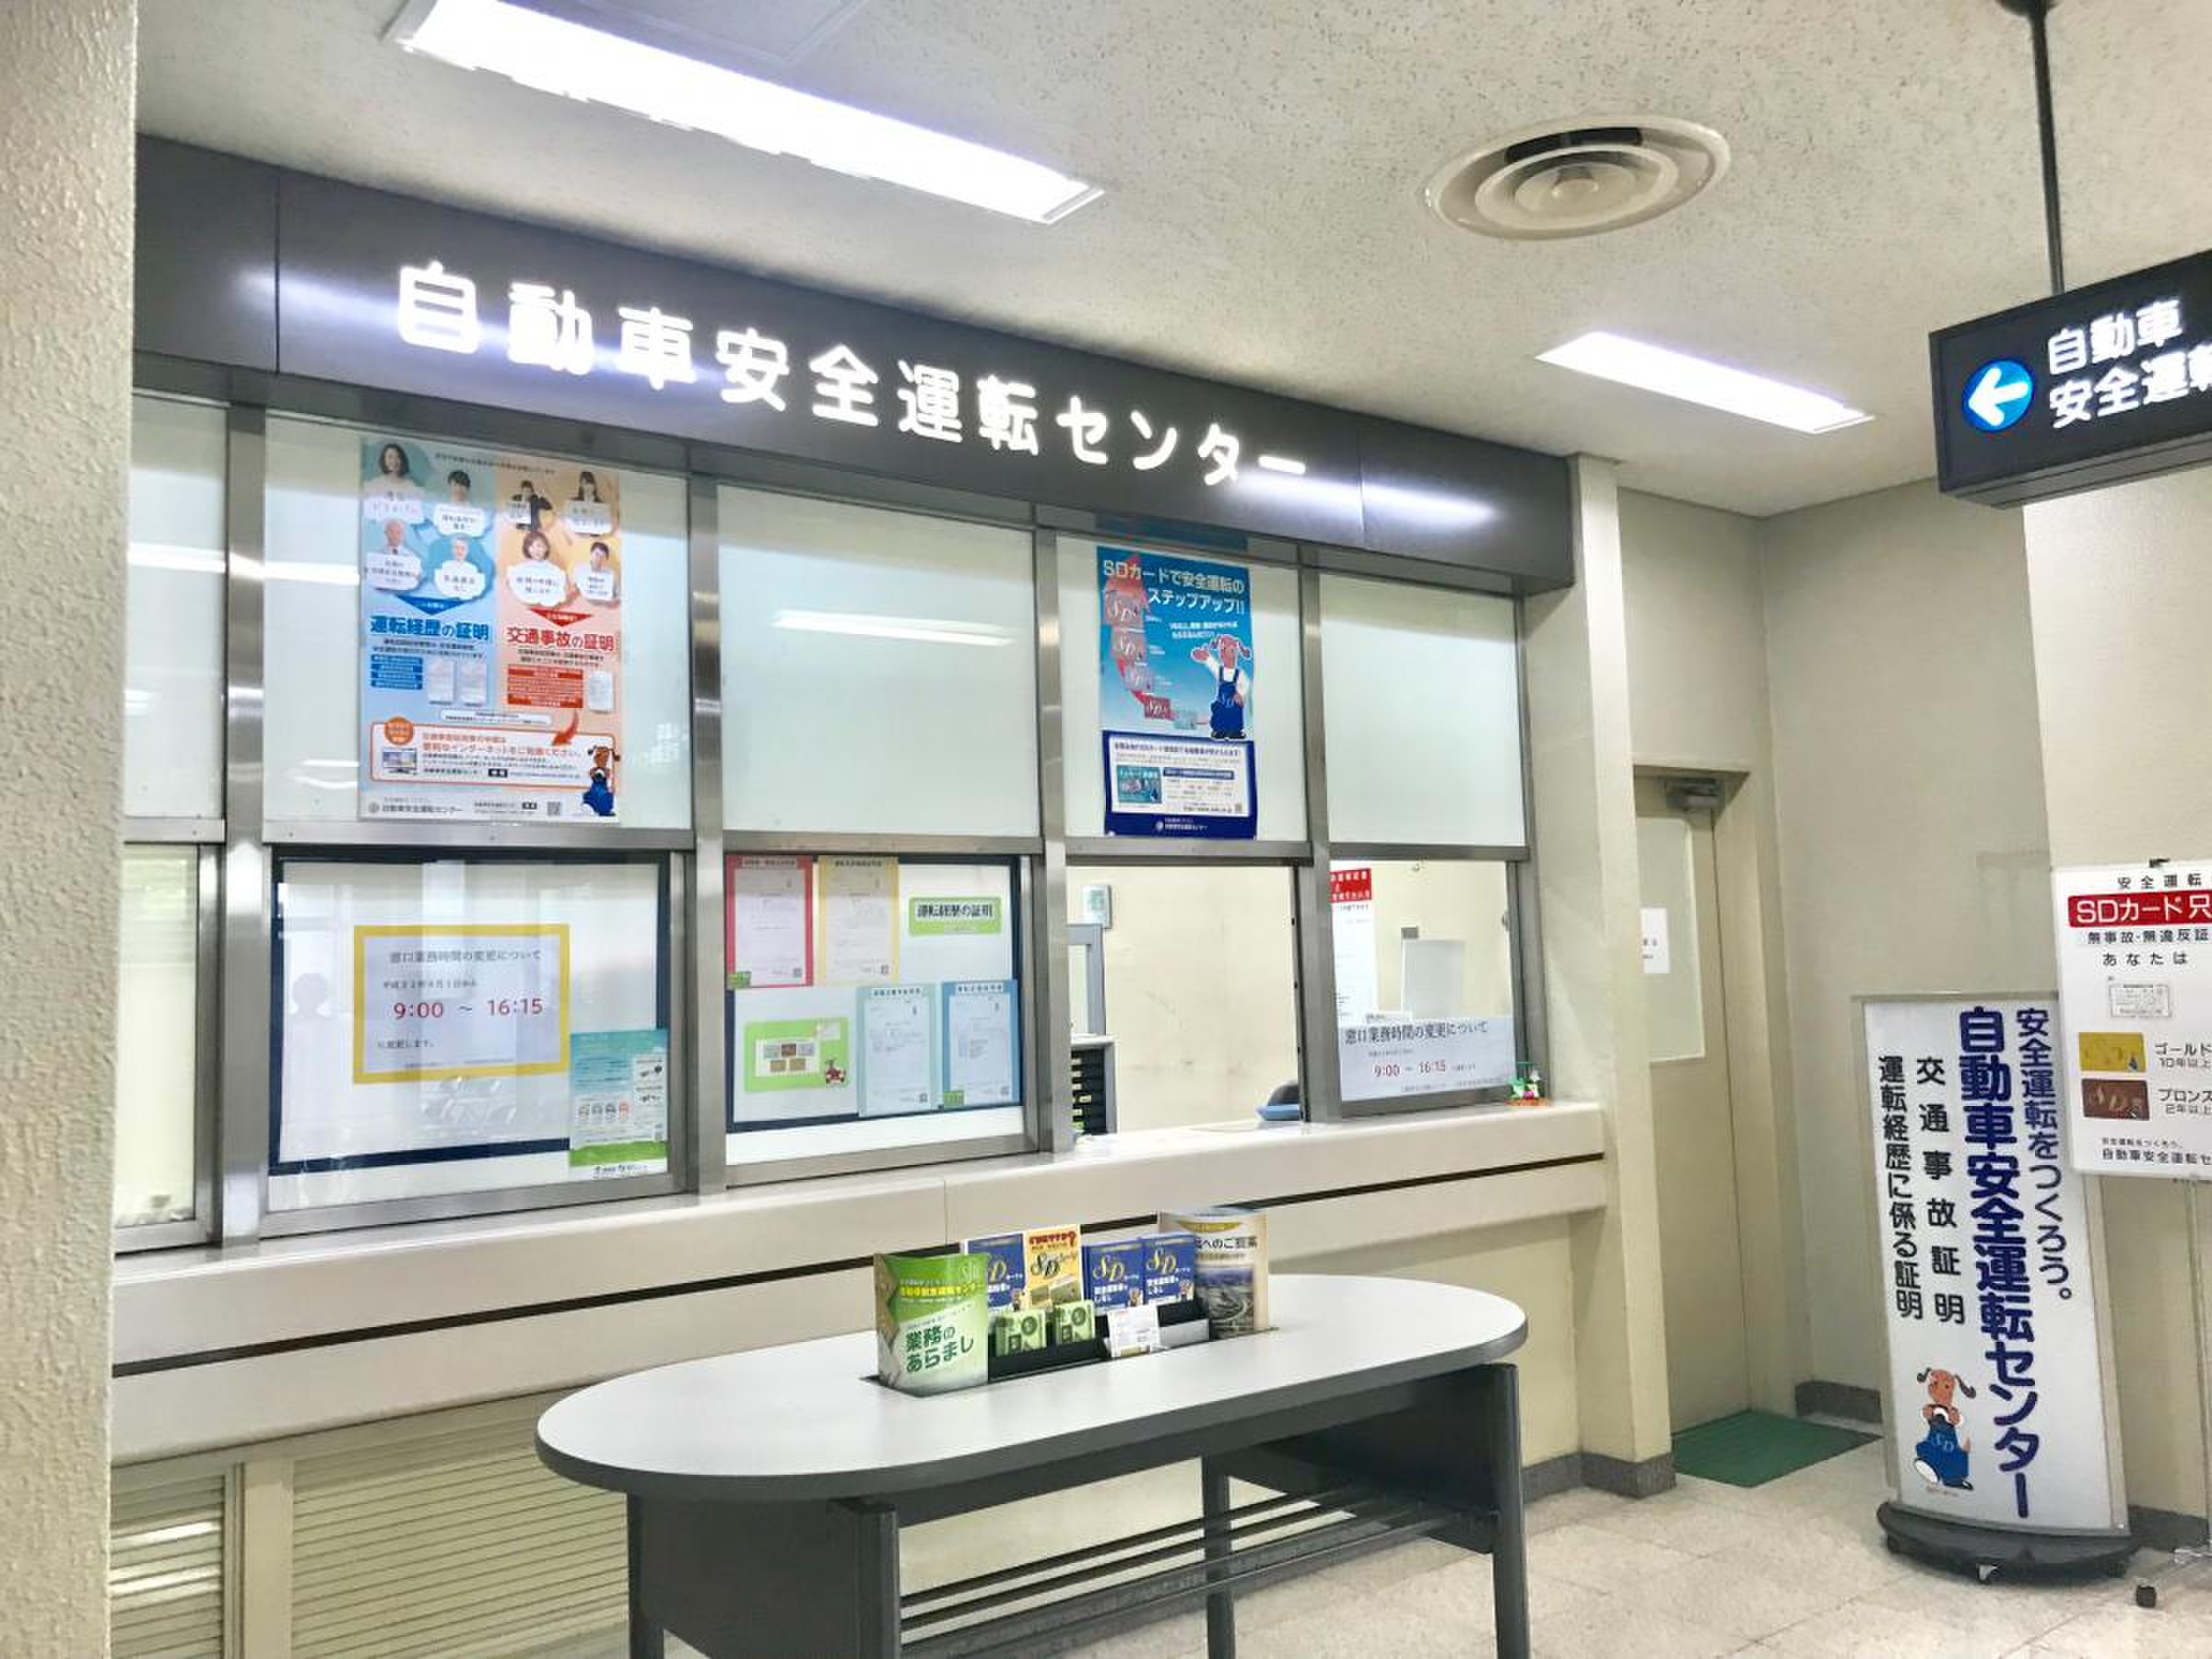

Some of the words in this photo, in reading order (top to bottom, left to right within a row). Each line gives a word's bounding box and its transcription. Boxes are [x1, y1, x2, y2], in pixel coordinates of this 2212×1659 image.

[2048, 298, 2183, 375] 自動車
[397, 262, 1306, 486] 自動車安全運転センター
[1103, 559, 1244, 594] SDカードで安全運転の
[370, 616, 489, 641] 運転経歴の証明
[507, 627, 615, 651] 交通事故の証明
[2077, 893, 2212, 924] SDカード只
[2088, 928, 2209, 945] 無事故・無違反証
[390, 949, 542, 964] 窓口業務時間の変更について
[2102, 952, 2188, 967] あなたは
[393, 1002, 444, 1019] 9:00
[487, 996, 544, 1017] 16:15
[1345, 1021, 1489, 1045] 窓口業務時間の変更について
[1373, 1063, 1401, 1077] 9:00
[1416, 1060, 1446, 1074] 16:15
[2016, 1007, 2073, 1300] 安全運転をつくろう。
[1878, 1055, 1924, 1320] 運転経歴に係る証明
[1916, 1055, 1965, 1324] 交通事故証明
[1958, 1006, 2040, 1518] 自動車安全運転センター
[905, 1324, 956, 1354] 業務の
[905, 1335, 974, 1373] あらまし
